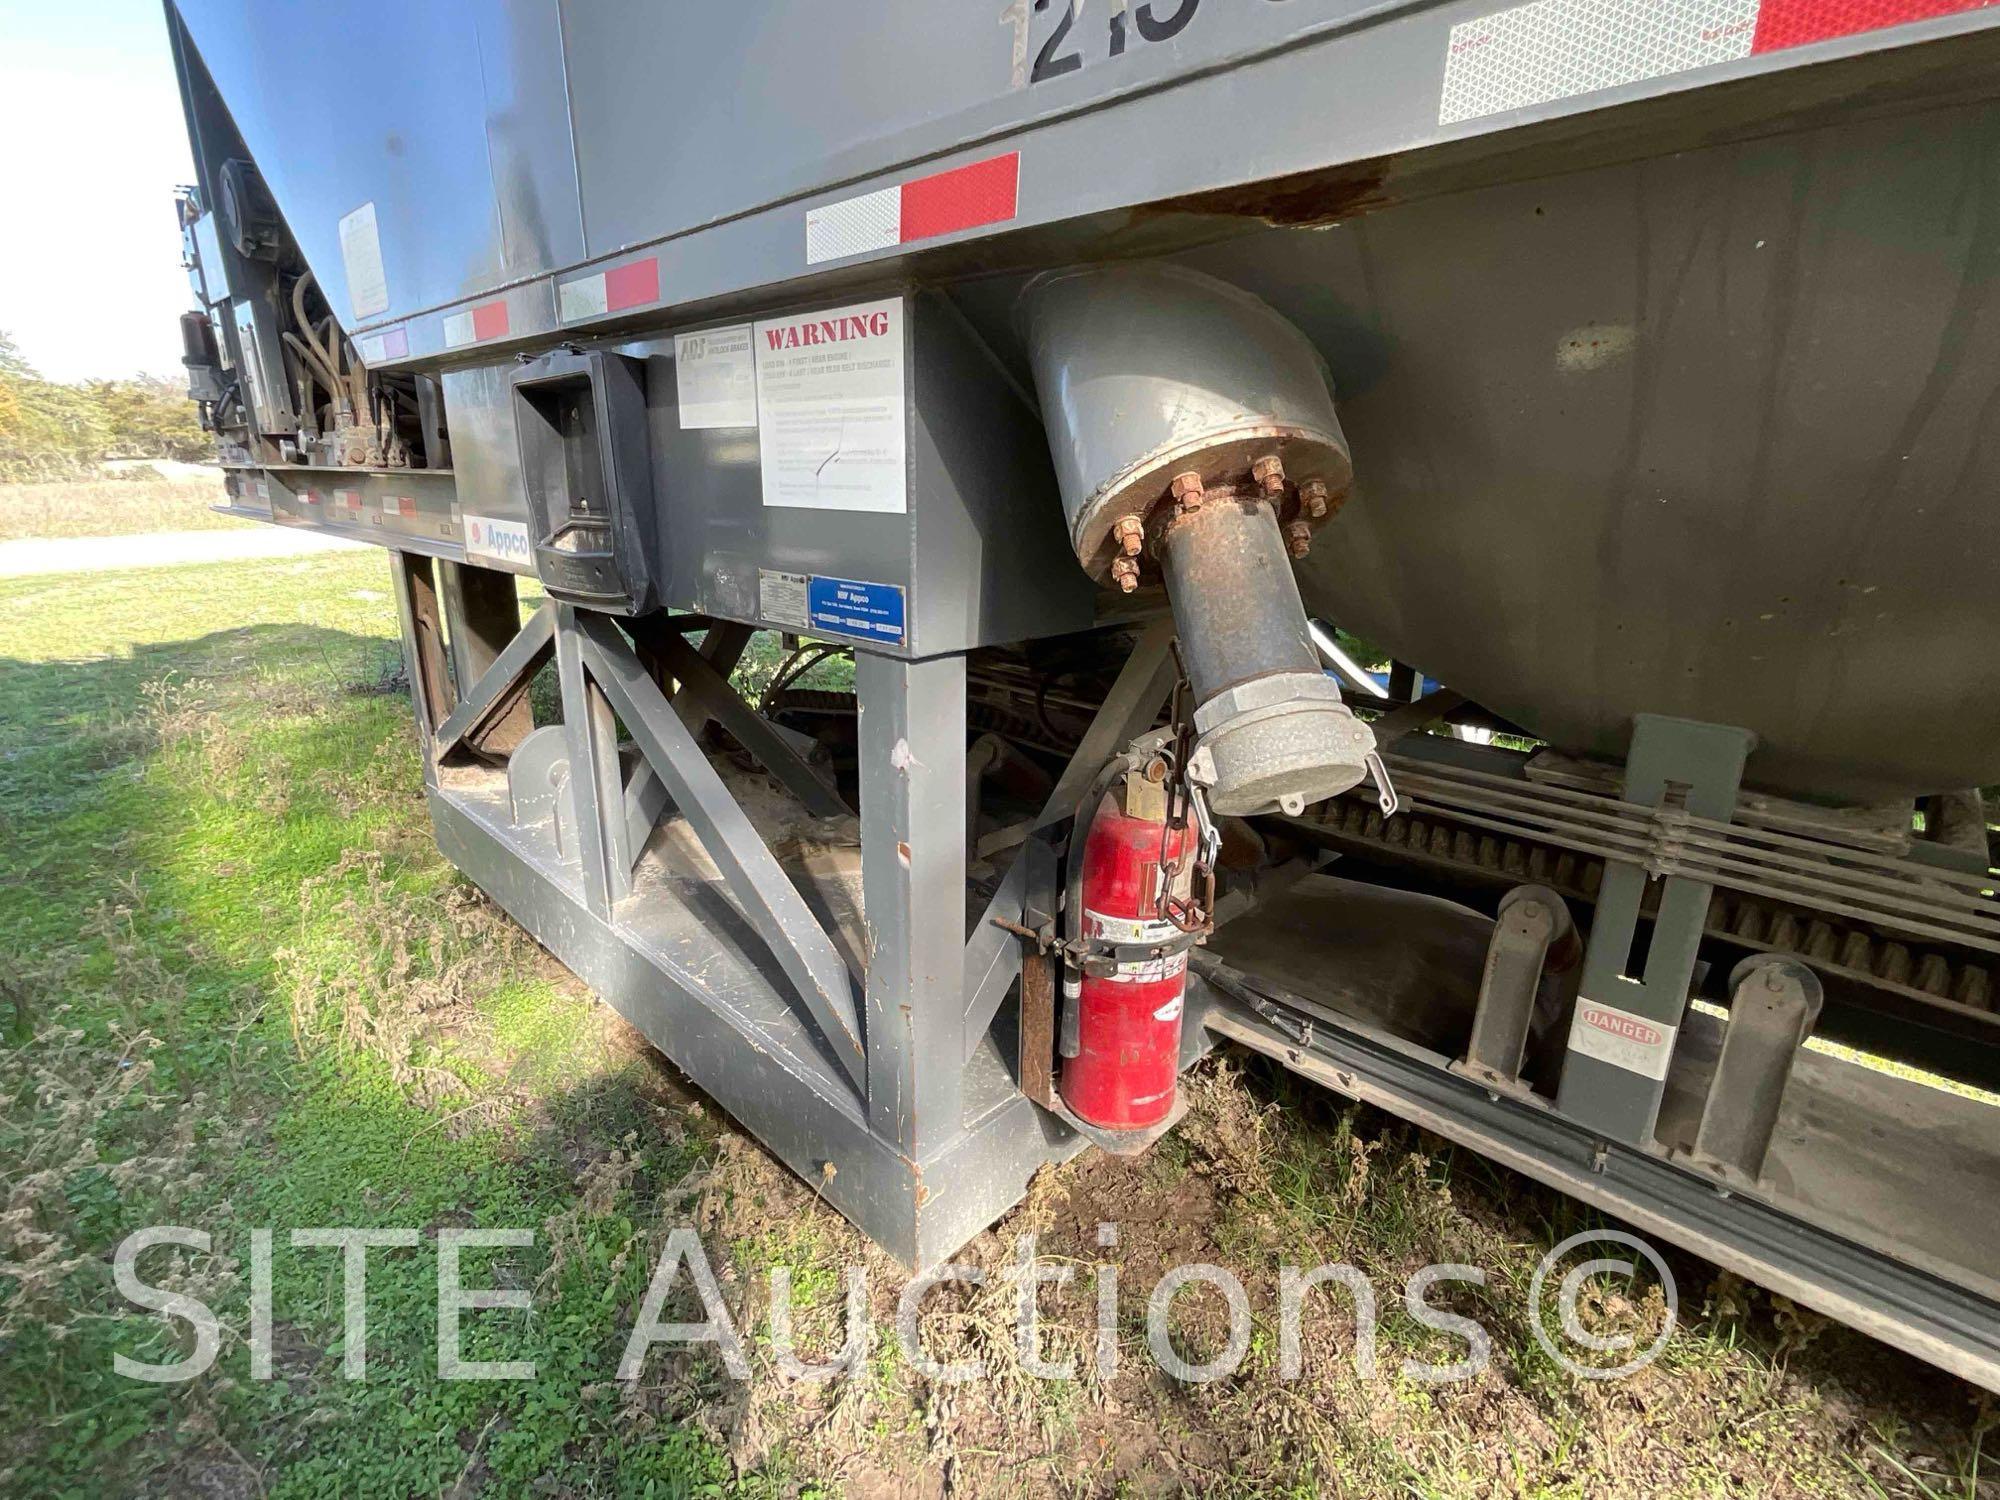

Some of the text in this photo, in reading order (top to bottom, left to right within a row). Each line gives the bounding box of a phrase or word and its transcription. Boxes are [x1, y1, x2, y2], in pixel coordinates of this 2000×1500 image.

[765, 311, 889, 351] WARNING
[488, 524, 528, 557] Appco
[1586, 1011, 1658, 1044] DANGER
